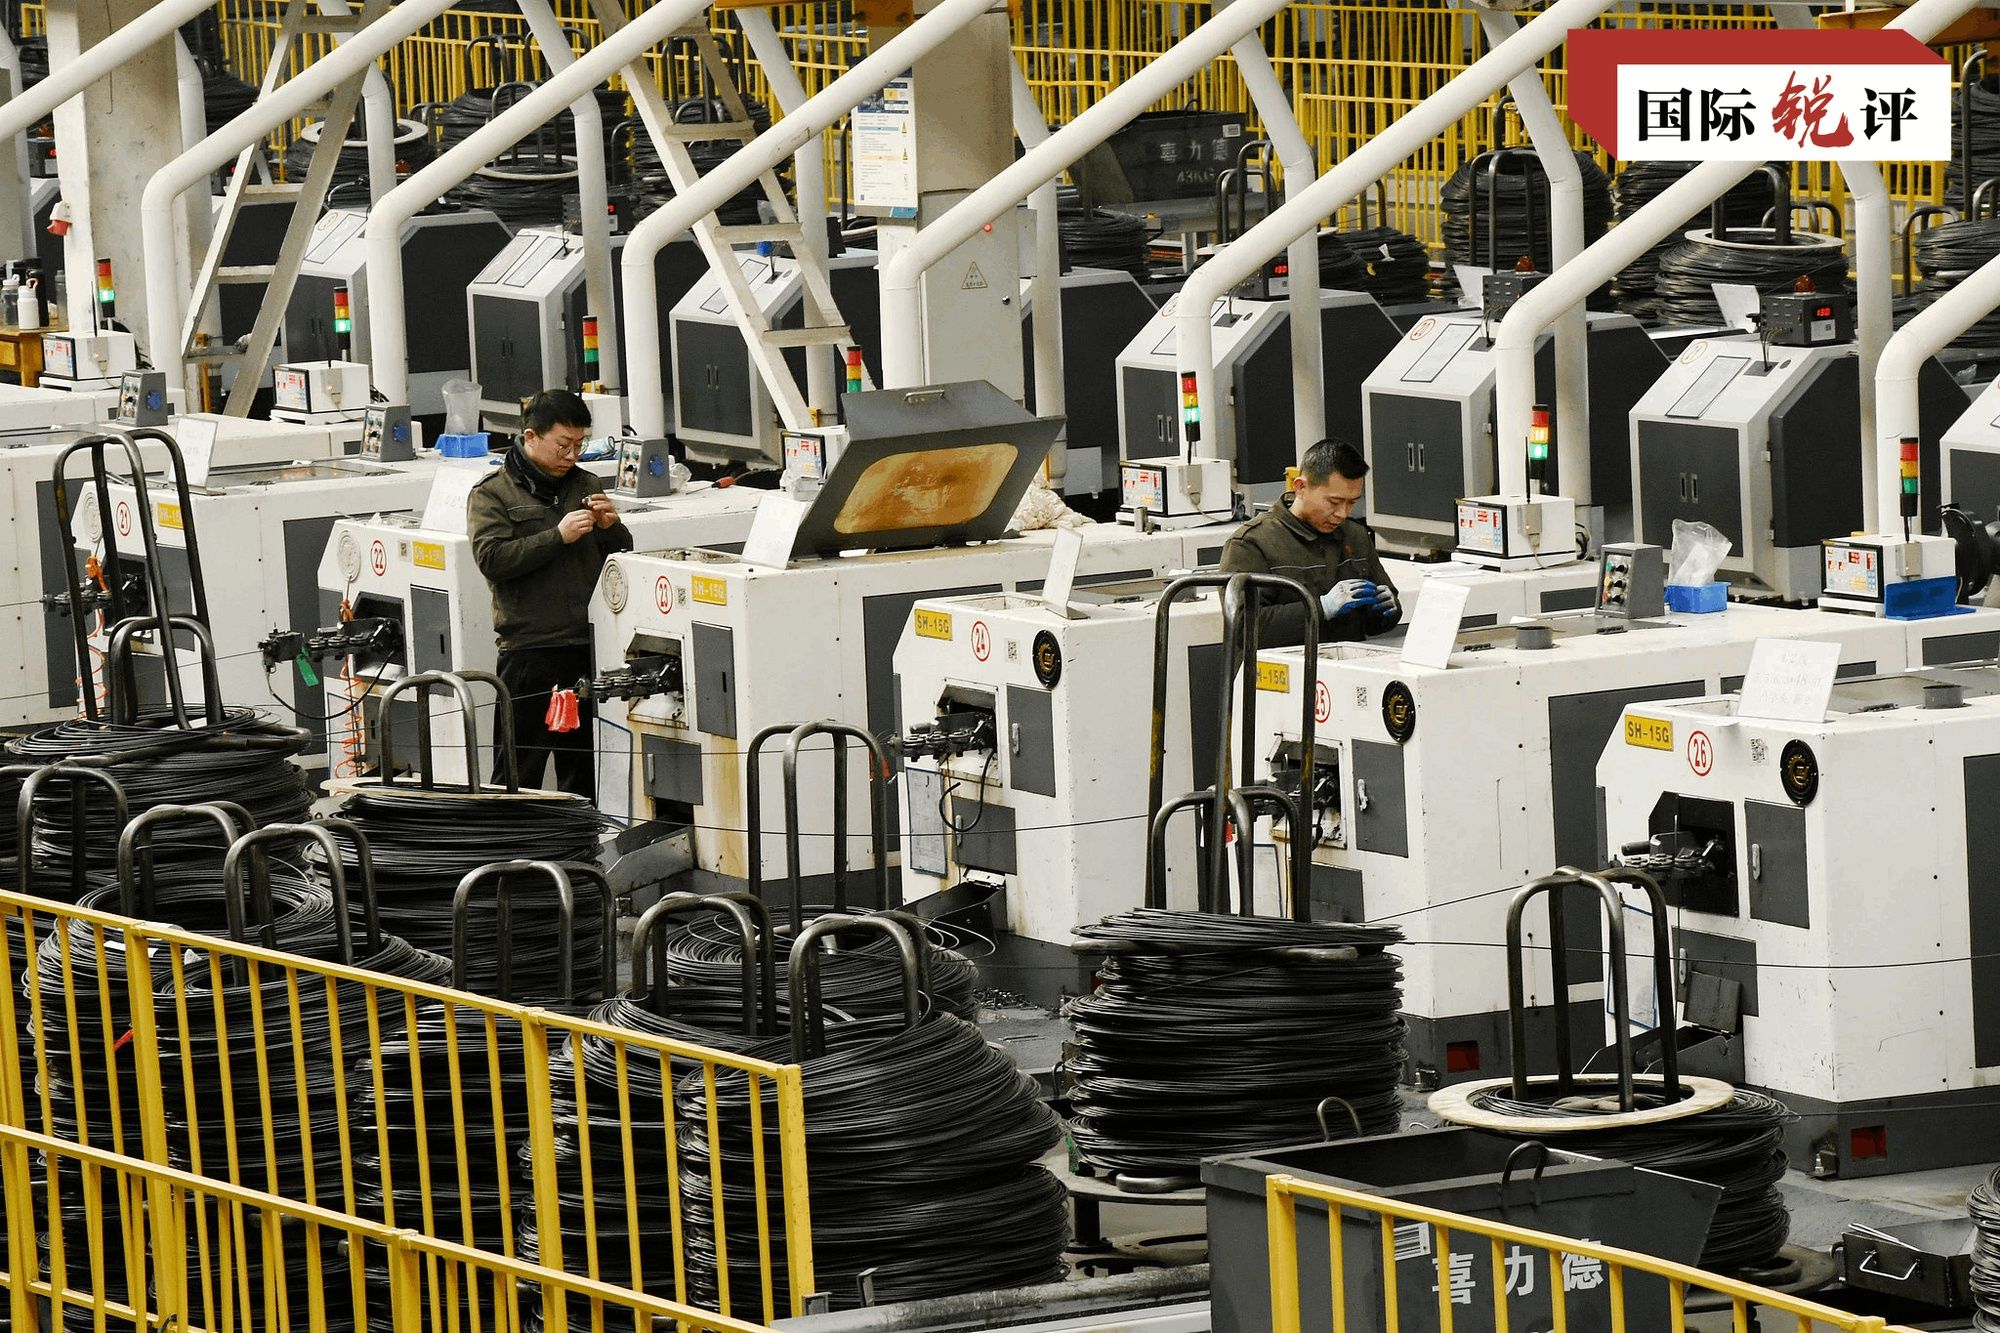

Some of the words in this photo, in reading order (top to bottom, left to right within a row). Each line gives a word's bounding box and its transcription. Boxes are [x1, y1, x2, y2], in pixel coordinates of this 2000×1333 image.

[374, 548, 383, 569] 22
[660, 583, 669, 607] 23
[917, 614, 949, 633] SH-15G
[976, 628, 985, 654] 24
[1628, 721, 1670, 743] SH-15G
[1693, 738, 1707, 768] 26
